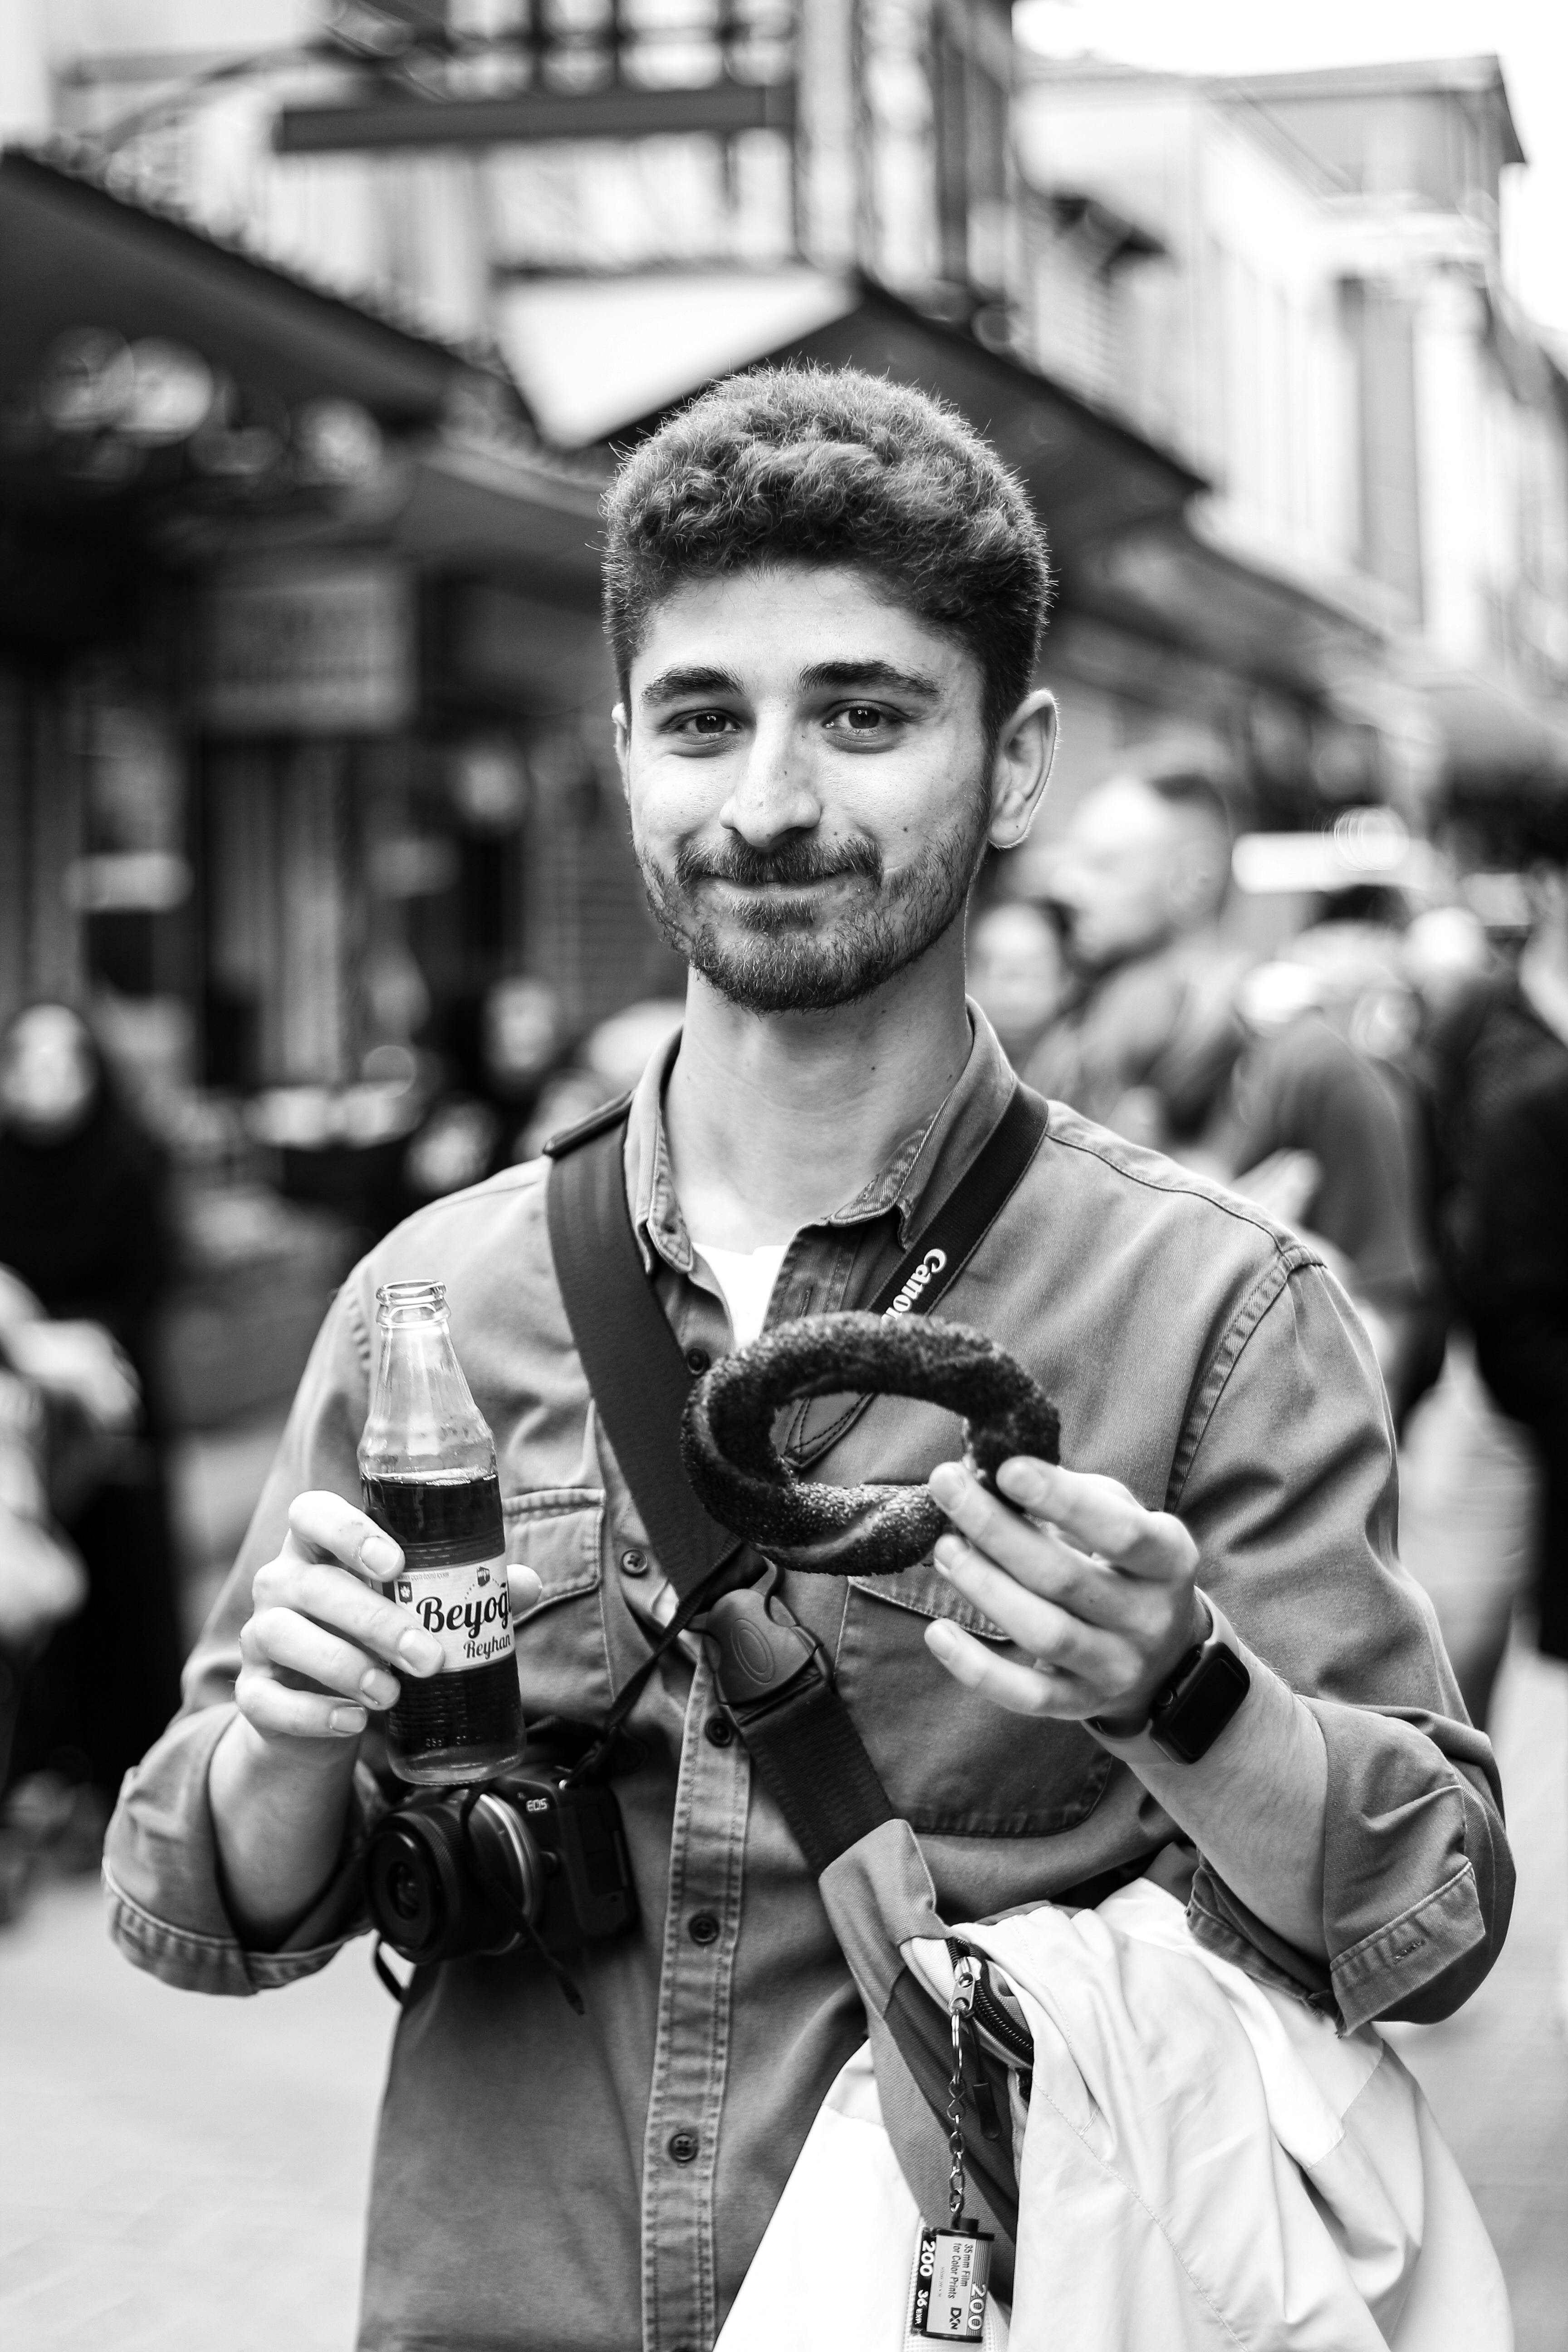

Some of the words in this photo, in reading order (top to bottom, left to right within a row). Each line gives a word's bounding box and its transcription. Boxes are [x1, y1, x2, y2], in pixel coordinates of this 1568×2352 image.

[463, 1634, 510, 1660] Reyhan
[526, 1798, 548, 1812] EOS
[953, 2243, 961, 2253] for
[920, 2240, 936, 2277] 200
[951, 2255, 961, 2274] Color
[948, 2277, 958, 2298] Prints
[960, 2271, 970, 2287] Film
[917, 2289, 929, 2307] 36
[968, 2283, 987, 2330] 200
